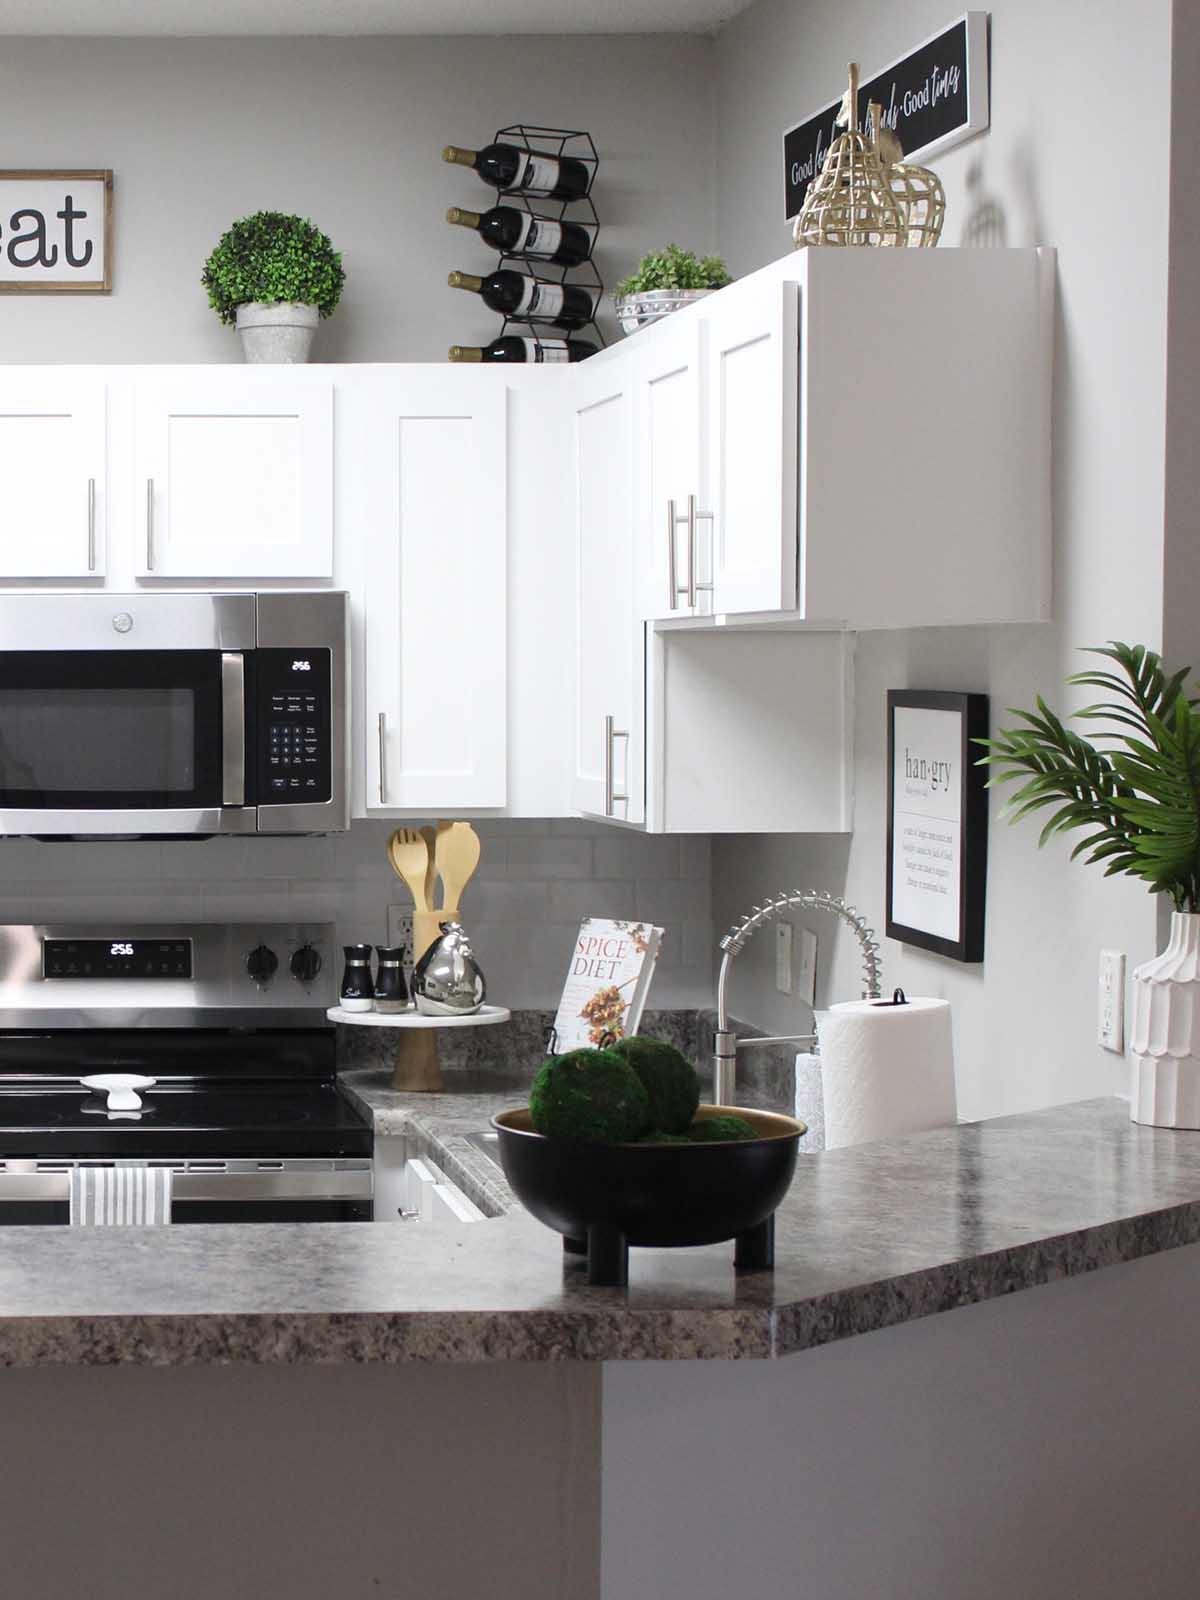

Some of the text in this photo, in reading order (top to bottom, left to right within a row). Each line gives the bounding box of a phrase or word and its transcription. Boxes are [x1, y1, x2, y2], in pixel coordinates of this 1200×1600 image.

[791, 153, 813, 185] Good
[903, 79, 929, 117] Good
[931, 64, 961, 108] times
[576, 935, 628, 959] SPICE
[573, 957, 622, 979] DIET
